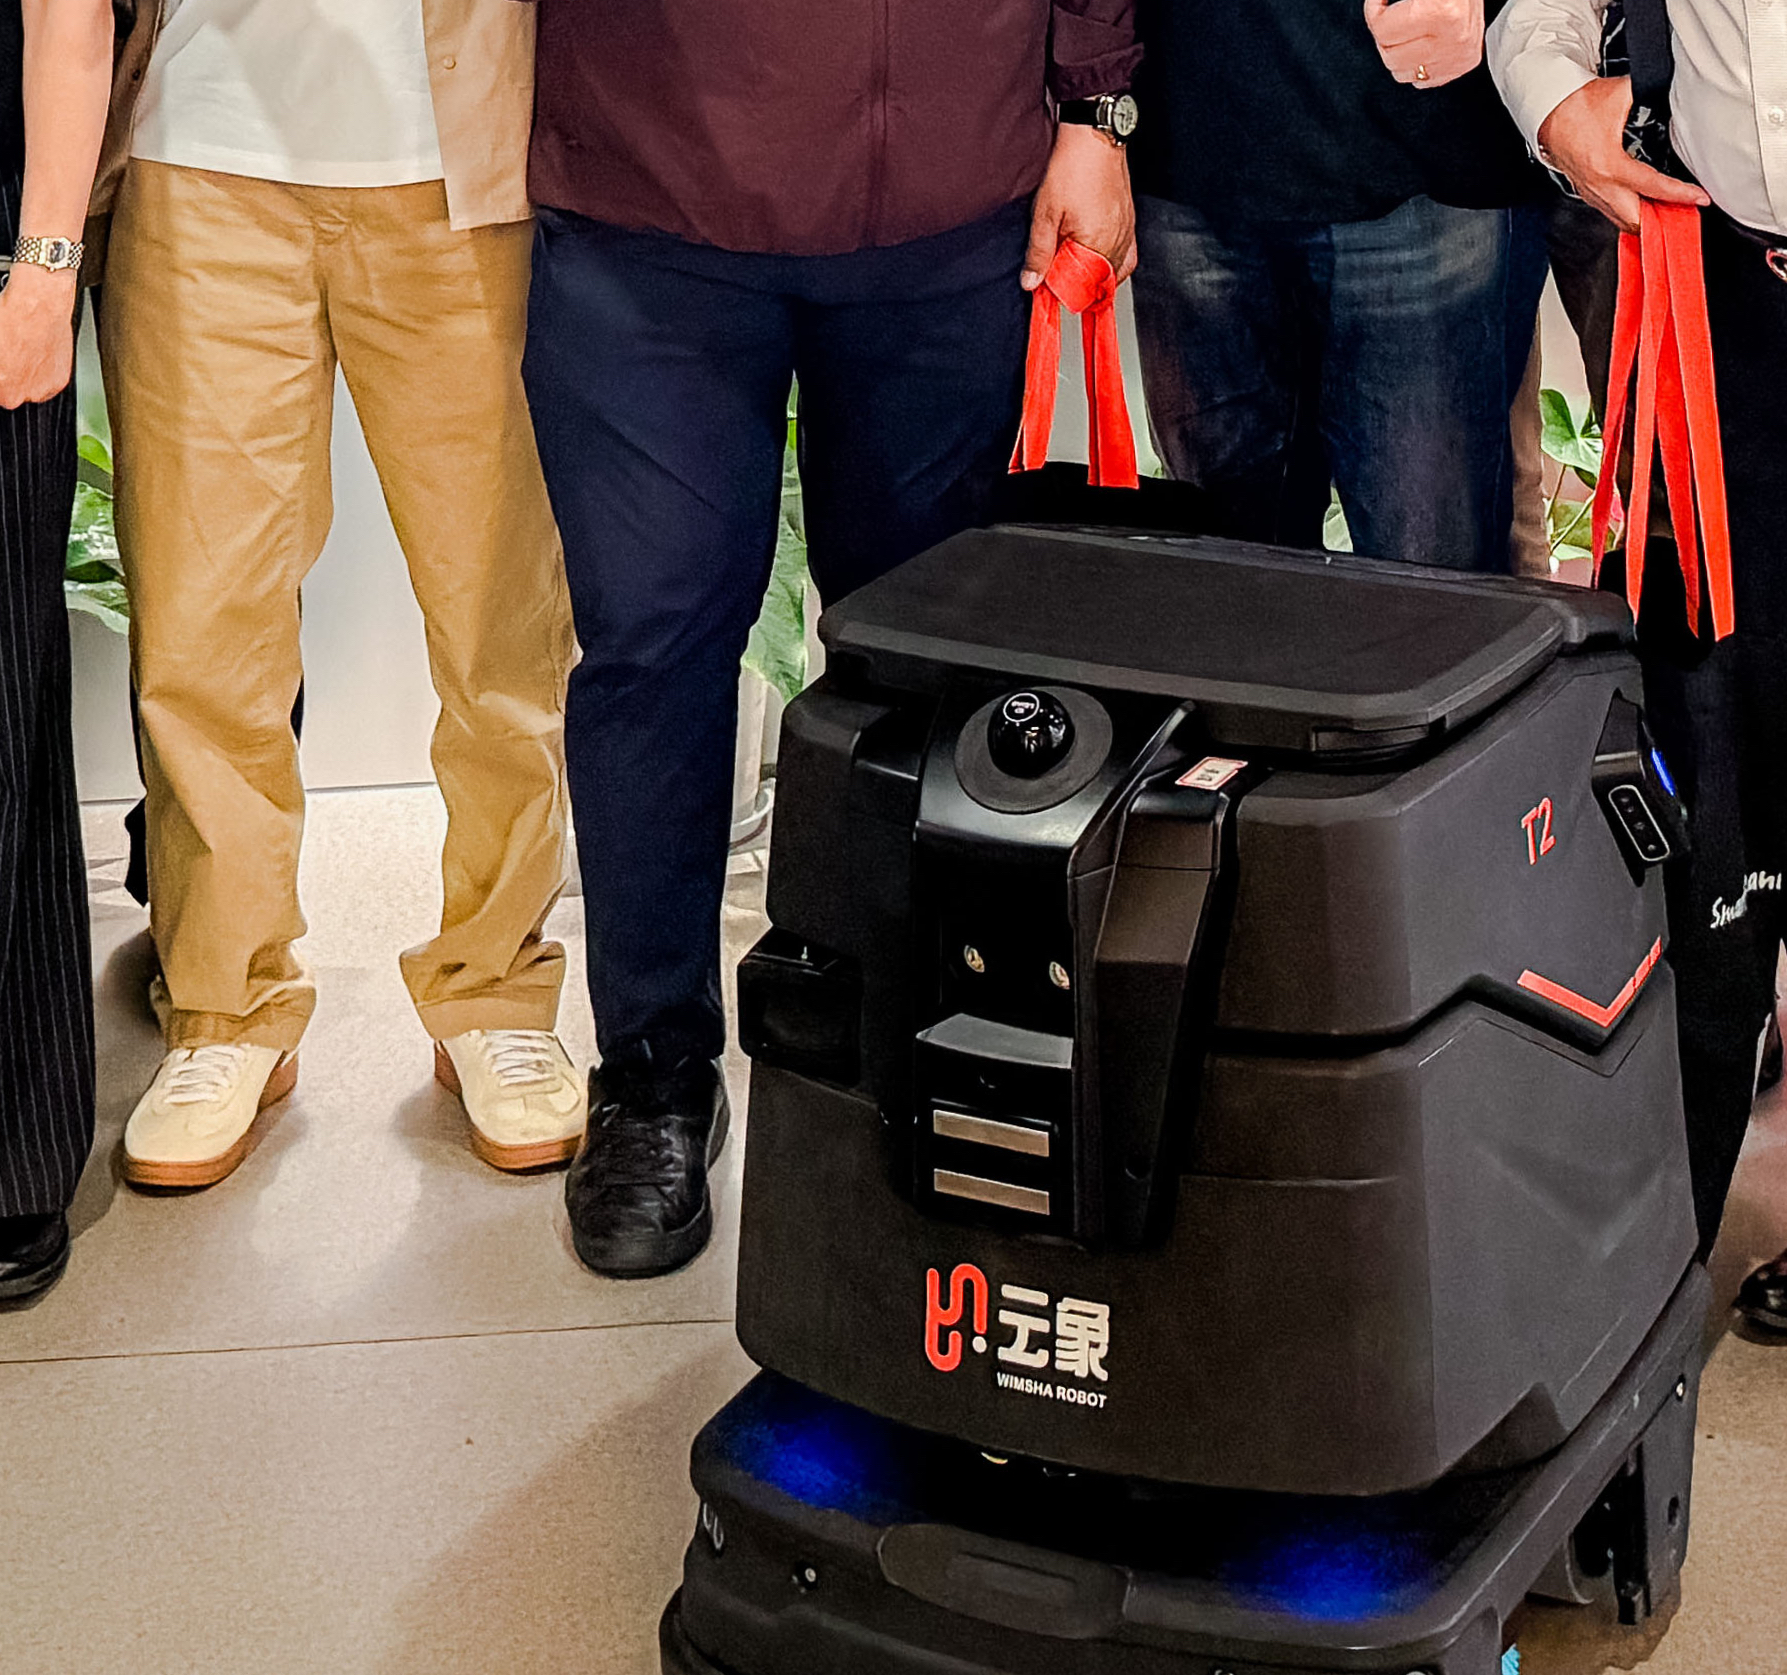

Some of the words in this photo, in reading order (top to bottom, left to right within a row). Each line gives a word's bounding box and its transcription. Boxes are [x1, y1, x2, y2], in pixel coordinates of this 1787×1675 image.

[1521, 797, 1556, 865] T2
[998, 1283, 1110, 1382] 云象
[996, 1371, 1053, 1399] WIMSHA
[1056, 1385, 1107, 1409] ROBOT
